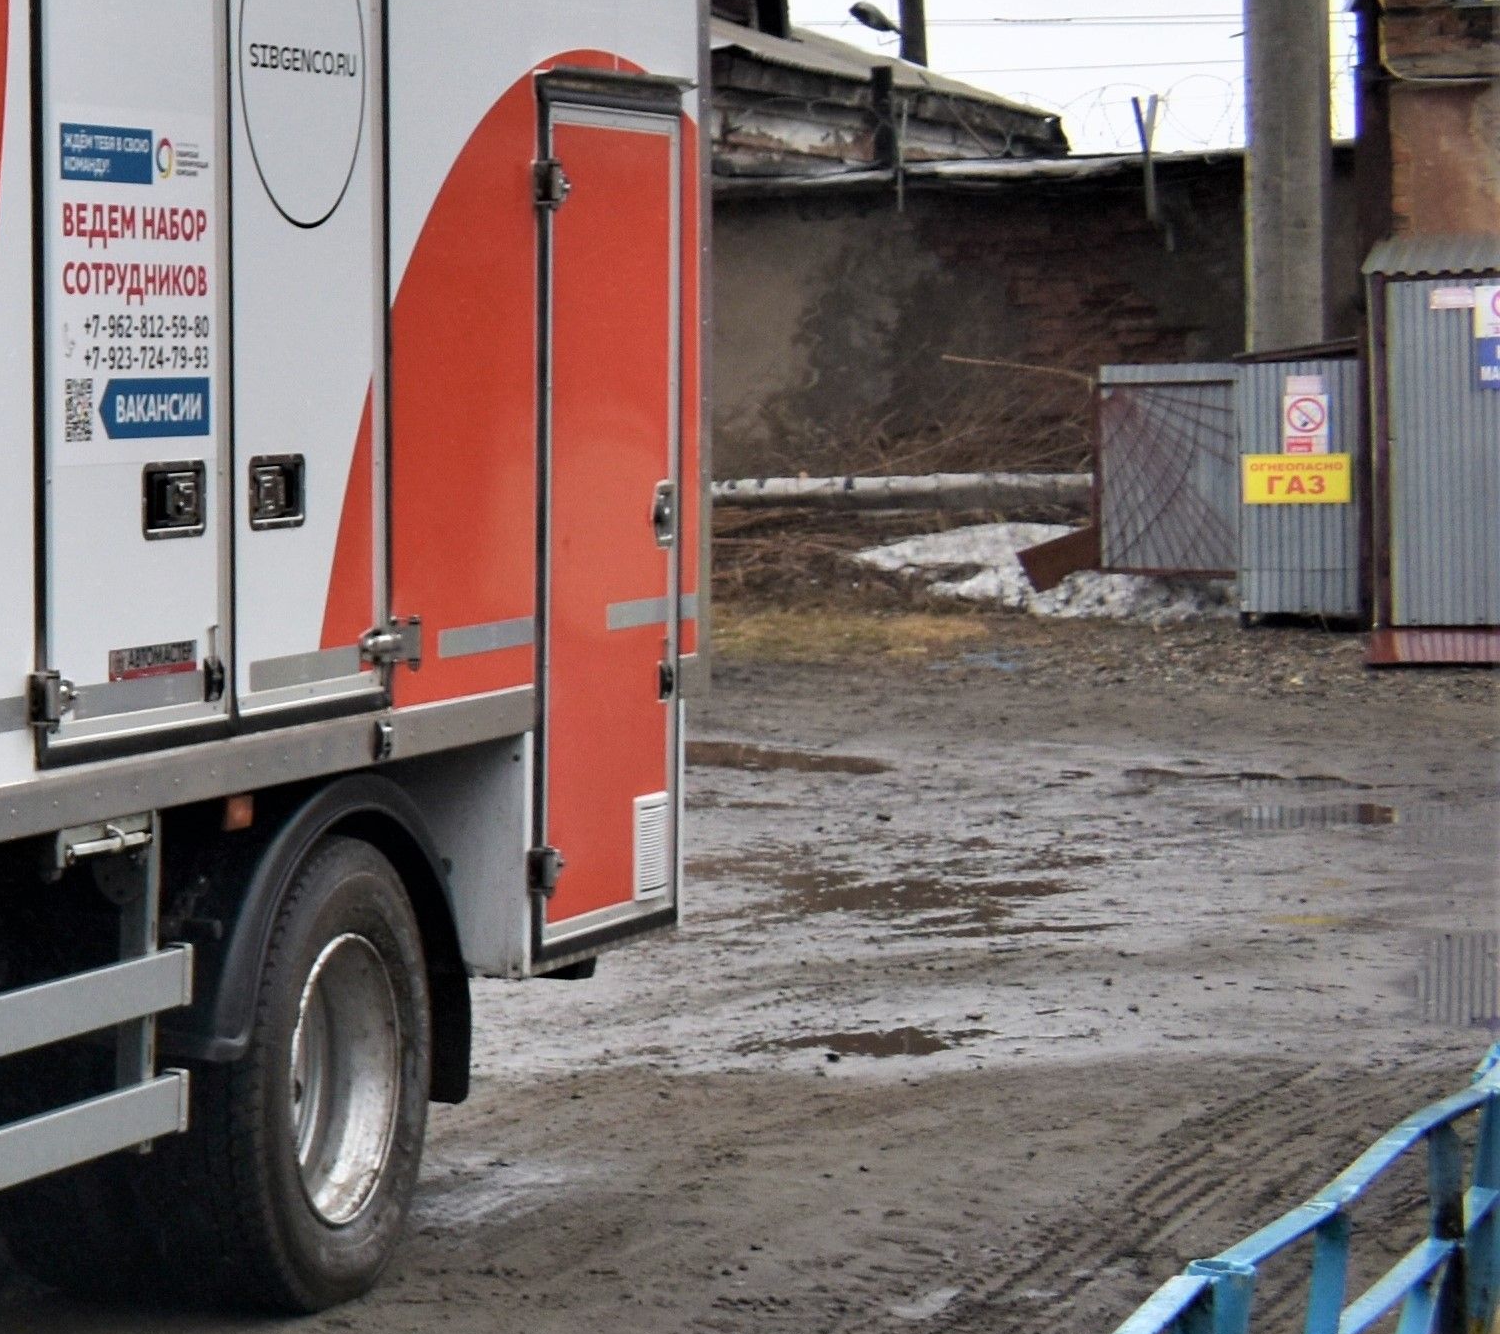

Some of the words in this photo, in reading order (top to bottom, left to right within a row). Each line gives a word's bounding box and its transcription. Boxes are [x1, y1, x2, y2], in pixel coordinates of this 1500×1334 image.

[249, 43, 357, 77] SIBGENCO.RU
[62, 202, 136, 249] ВЕДЕМ
[142, 206, 208, 242] НАБОР
[62, 261, 208, 306] СОТРУДНИКОВ
[84, 314, 210, 338] +7-962-812-59-80
[84, 346, 210, 370] +7-923-724-79-93
[115, 392, 203, 423] ВАКАНСИИ
[1250, 461, 1344, 472] ОГНЕОПАСНО
[1266, 474, 1325, 495] ГАЗ
